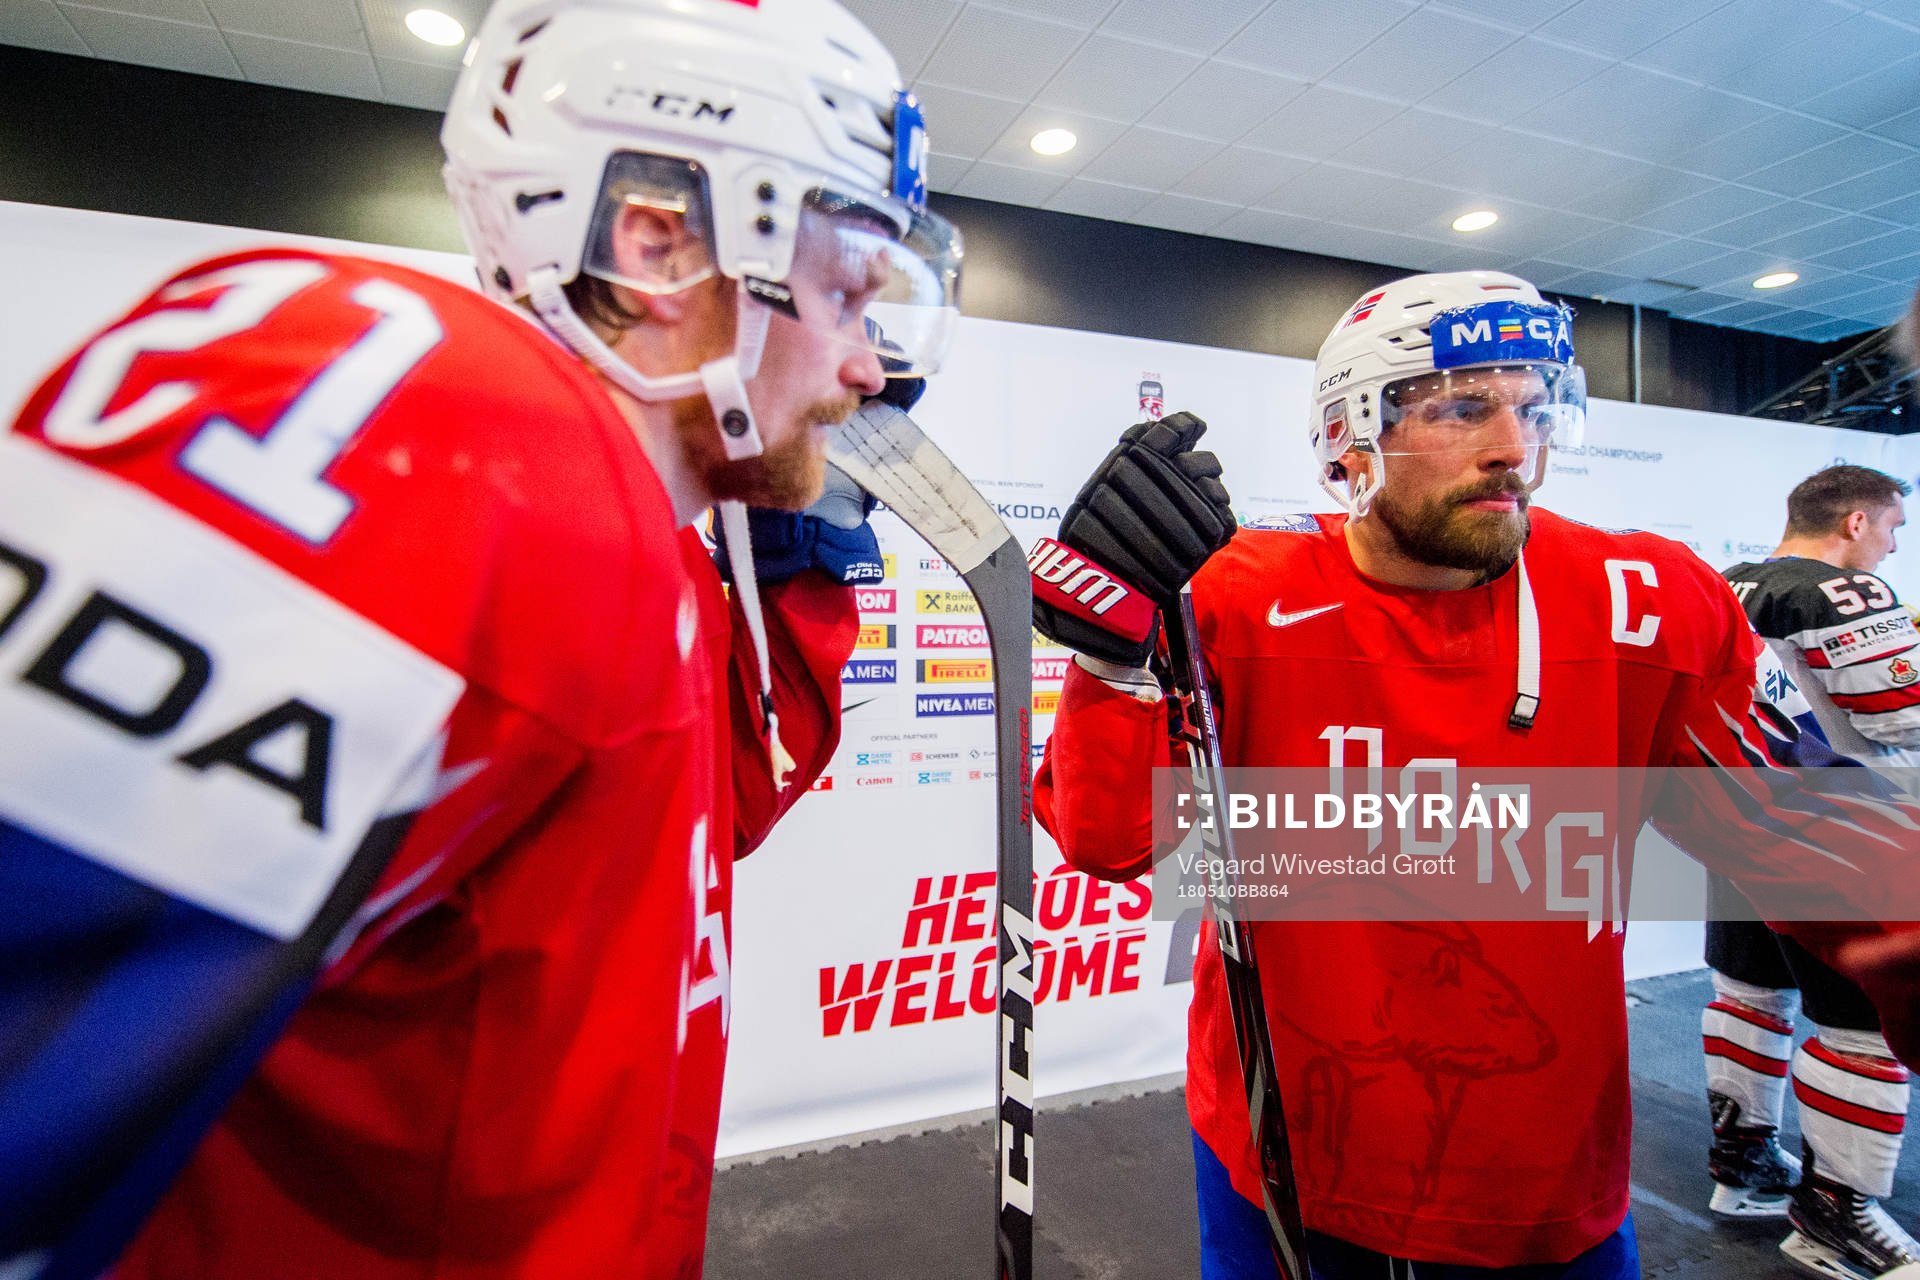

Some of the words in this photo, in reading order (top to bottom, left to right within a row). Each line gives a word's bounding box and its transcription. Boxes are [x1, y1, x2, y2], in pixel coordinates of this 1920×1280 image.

[1319, 367, 1353, 393] CCM
[42, 259, 446, 550] 21
[991, 500, 1061, 520] KODA
[1604, 559, 1662, 647] C
[1817, 574, 1894, 616] 53
[945, 604, 976, 613] BANK
[1854, 616, 1908, 639] TISSOT
[856, 667, 895, 679] MEN
[931, 664, 986, 678] PIRELLI
[918, 697, 963, 713] NIVEA
[856, 776, 893, 786] Canon
[1316, 725, 1625, 944] NORG
[902, 863, 1157, 949] HEOES
[1001, 902, 1034, 1216] CCM
